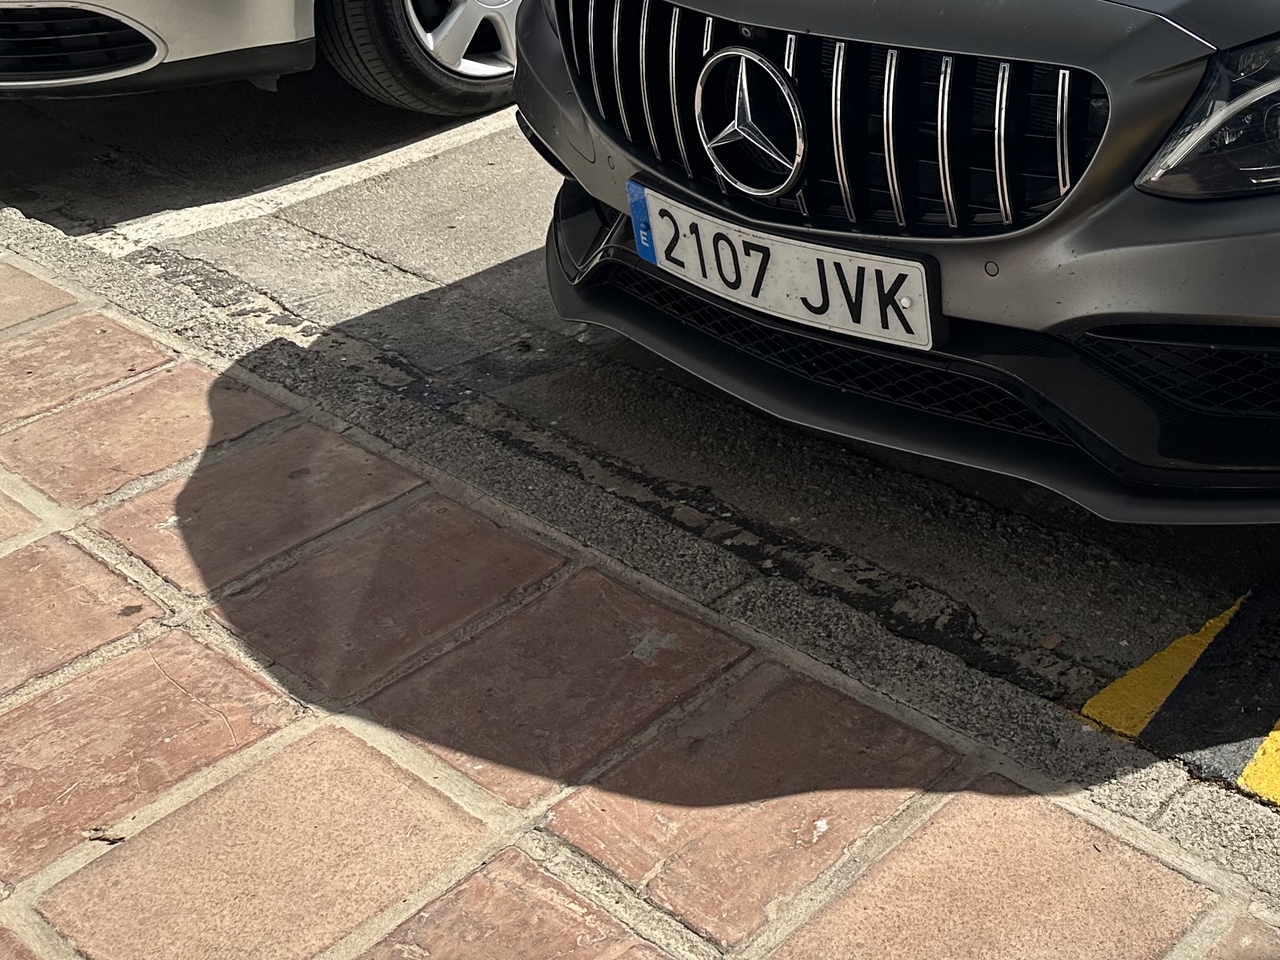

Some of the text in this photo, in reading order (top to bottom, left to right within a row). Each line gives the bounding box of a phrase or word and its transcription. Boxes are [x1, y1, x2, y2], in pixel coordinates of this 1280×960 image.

[638, 229, 650, 248] E
[658, 208, 915, 335] 2107 JVK
